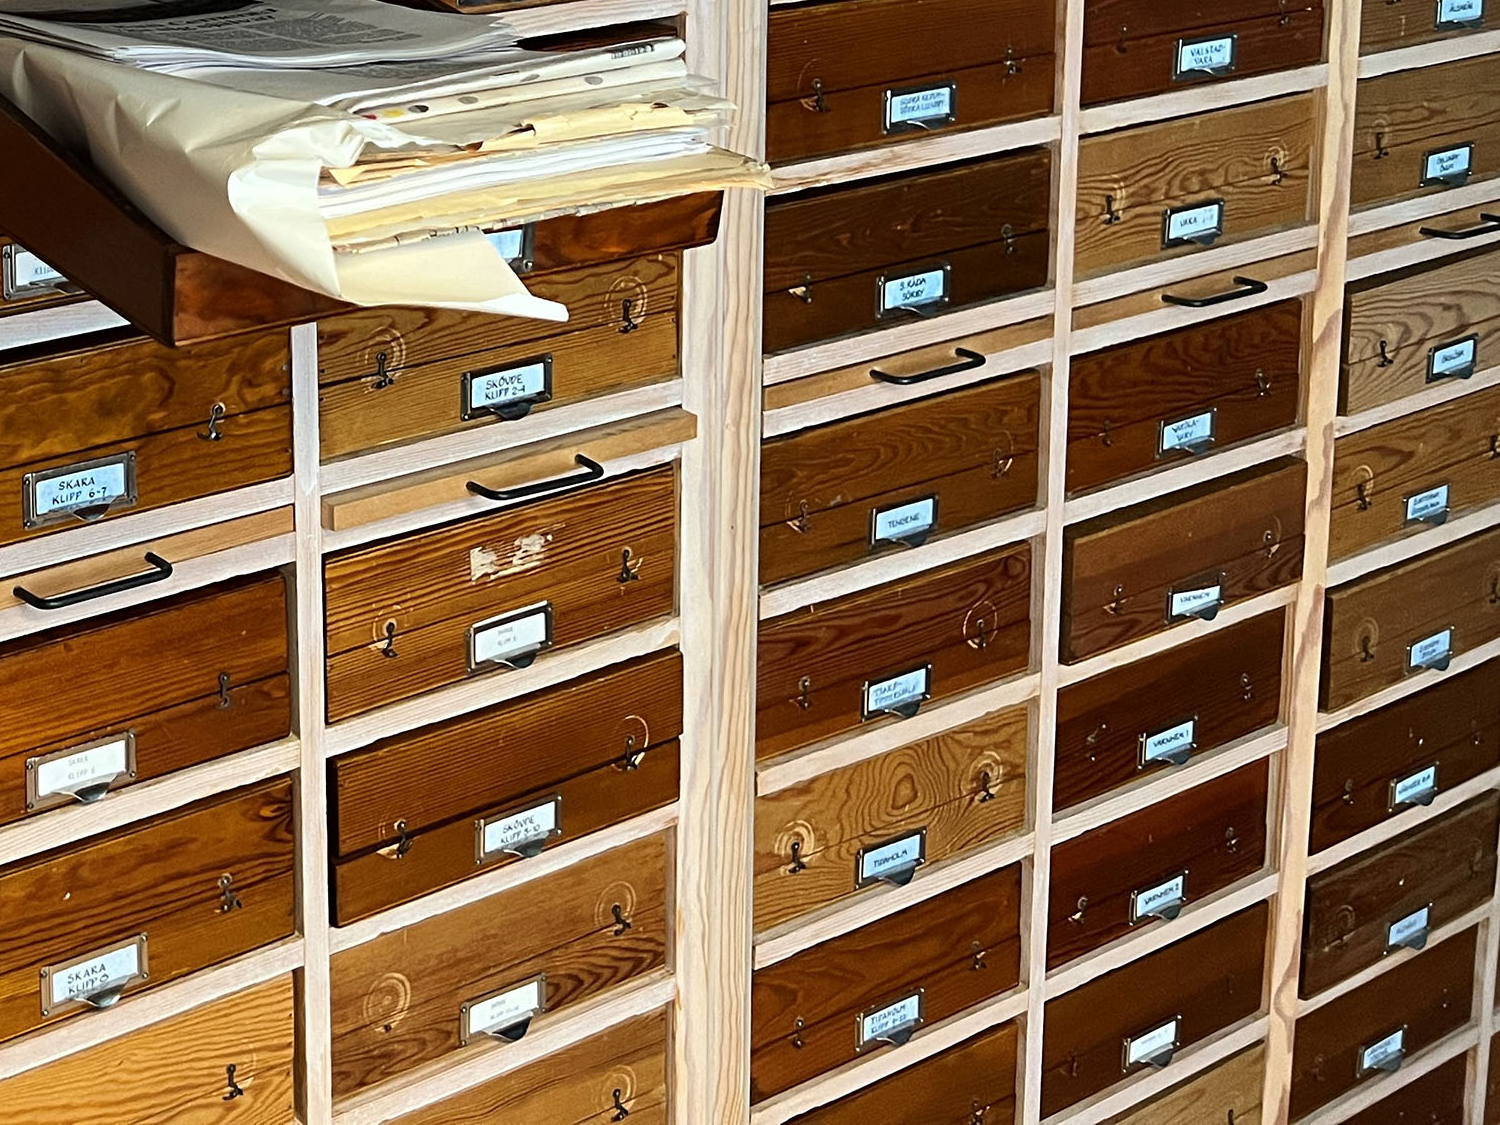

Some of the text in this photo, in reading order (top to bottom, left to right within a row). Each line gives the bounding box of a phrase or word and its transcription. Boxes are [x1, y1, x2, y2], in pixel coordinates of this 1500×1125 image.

[486, 374, 523, 390] SKÖVDE
[485, 388, 510, 401] KLIPP
[58, 477, 96, 491] SKARA
[52, 486, 108, 505] KLIPP 6-7
[67, 963, 106, 984] SKARA
